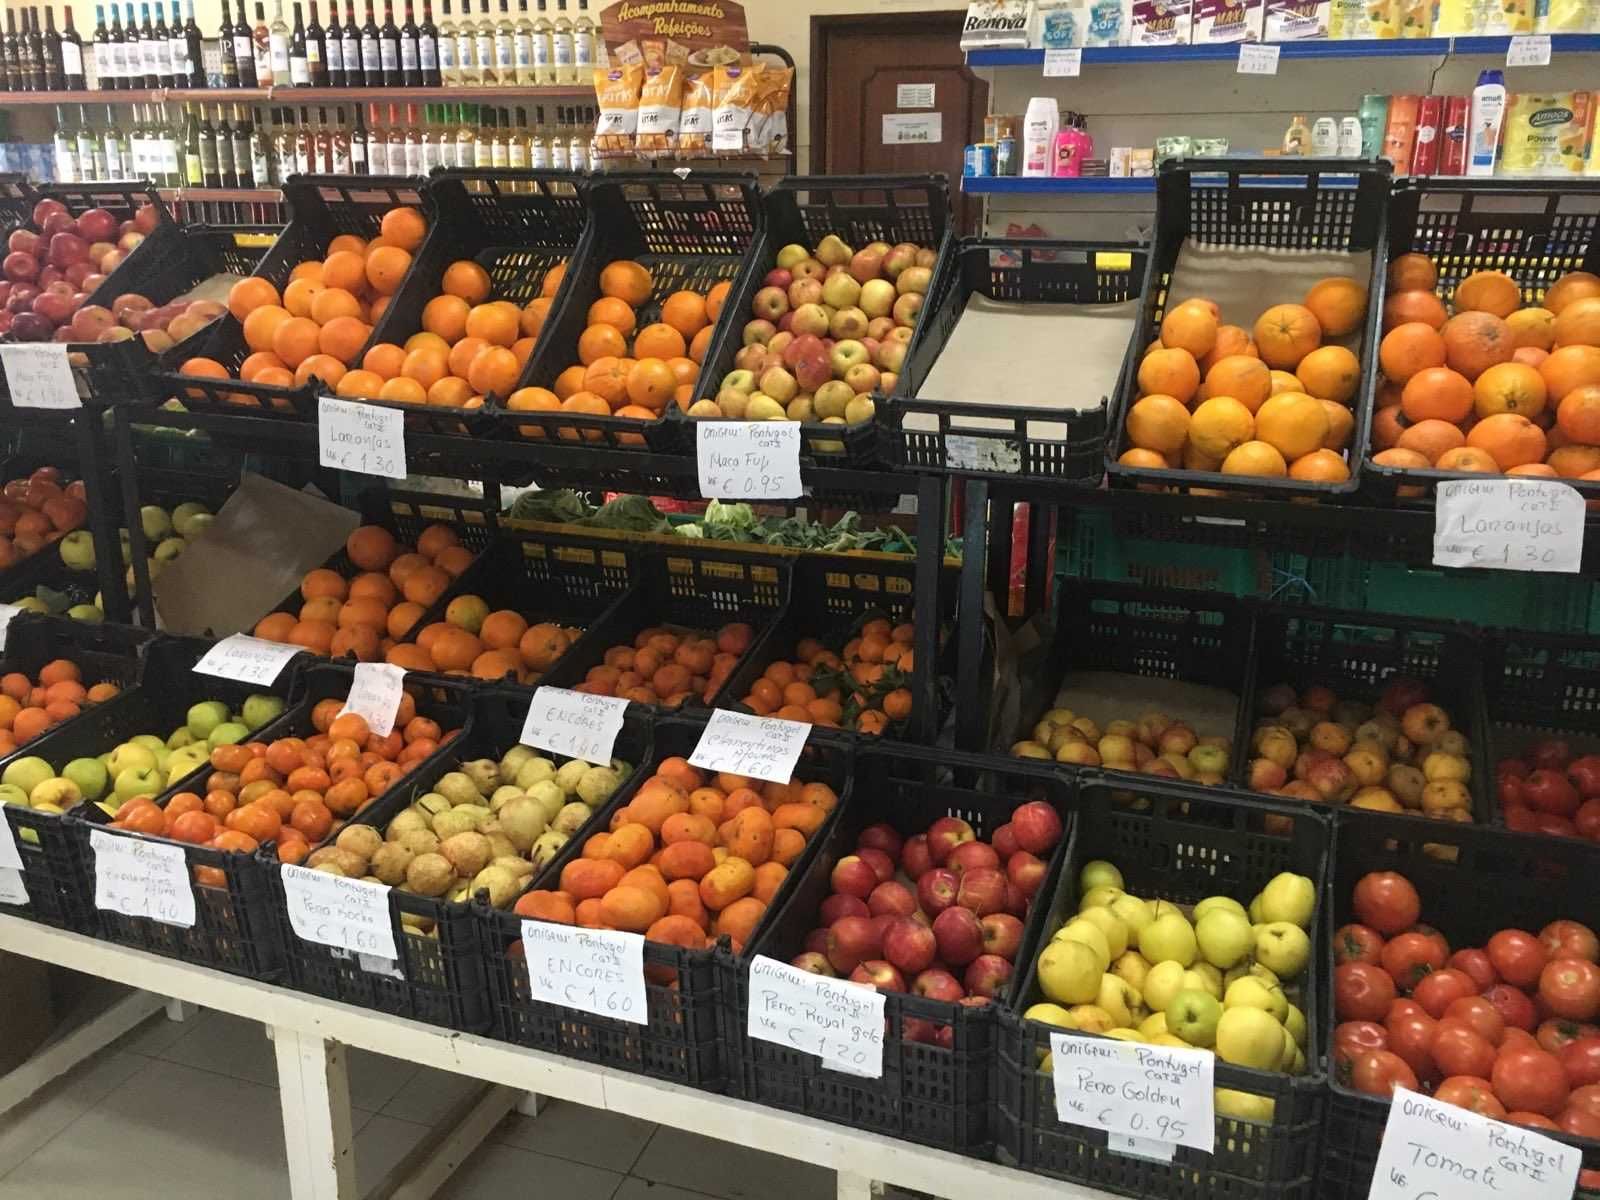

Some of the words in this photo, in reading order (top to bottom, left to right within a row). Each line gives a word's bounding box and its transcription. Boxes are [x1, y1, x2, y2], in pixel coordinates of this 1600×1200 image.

[618, 1, 725, 21] Acompanhamento
[653, 17, 712, 37] Refeições
[965, 16, 1027, 31] Renova
[1092, 20, 1121, 31] SOFT
[1047, 30, 1073, 41] SOFT
[1527, 135, 1558, 143] Power
[744, 475, 784, 496] 0.95
[1461, 515, 1563, 538] Laranjas
[799, 1001, 845, 1029] Royal
[1122, 1081, 1181, 1109] Golden
[1130, 1112, 1189, 1139] 0.95
